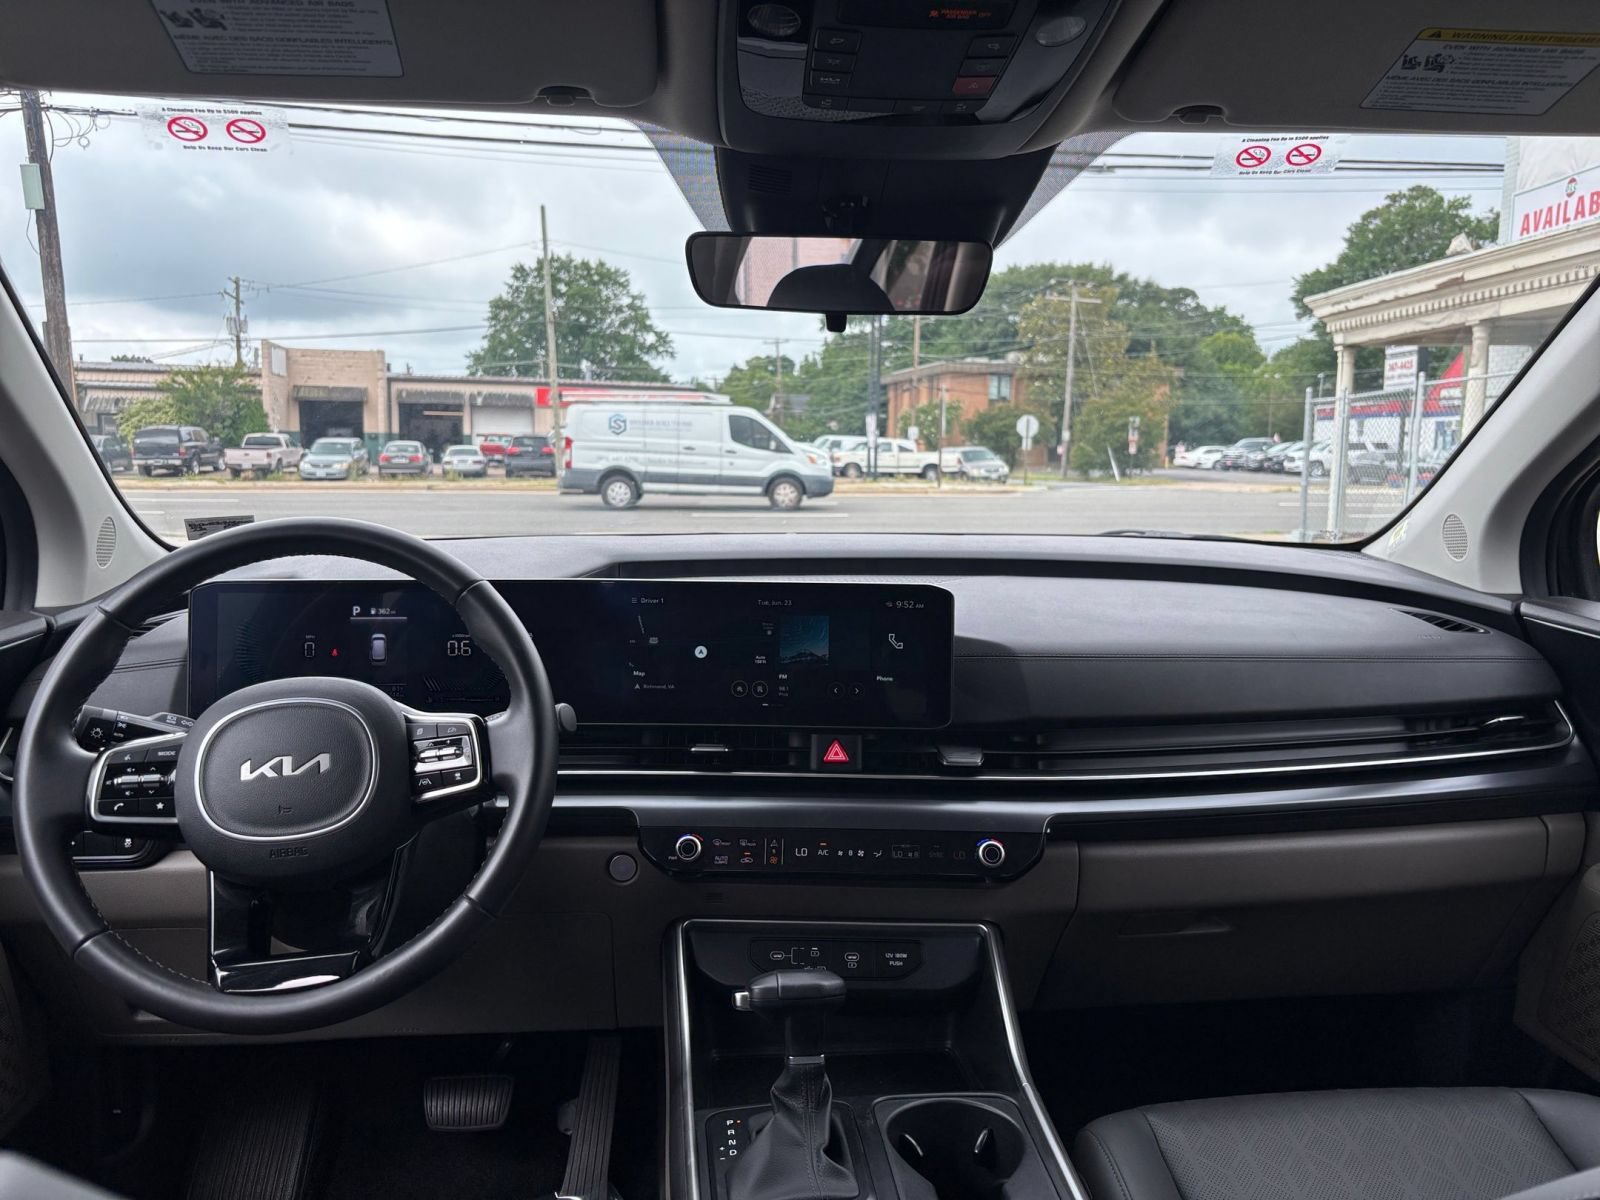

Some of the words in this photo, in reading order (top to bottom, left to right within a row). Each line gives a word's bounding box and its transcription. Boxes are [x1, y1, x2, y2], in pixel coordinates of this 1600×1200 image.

[352, 606, 361, 616] P
[896, 600, 914, 608] 9:52
[304, 642, 315, 657] 0
[447, 640, 472, 656] 0.6
[240, 753, 330, 781] KIA
